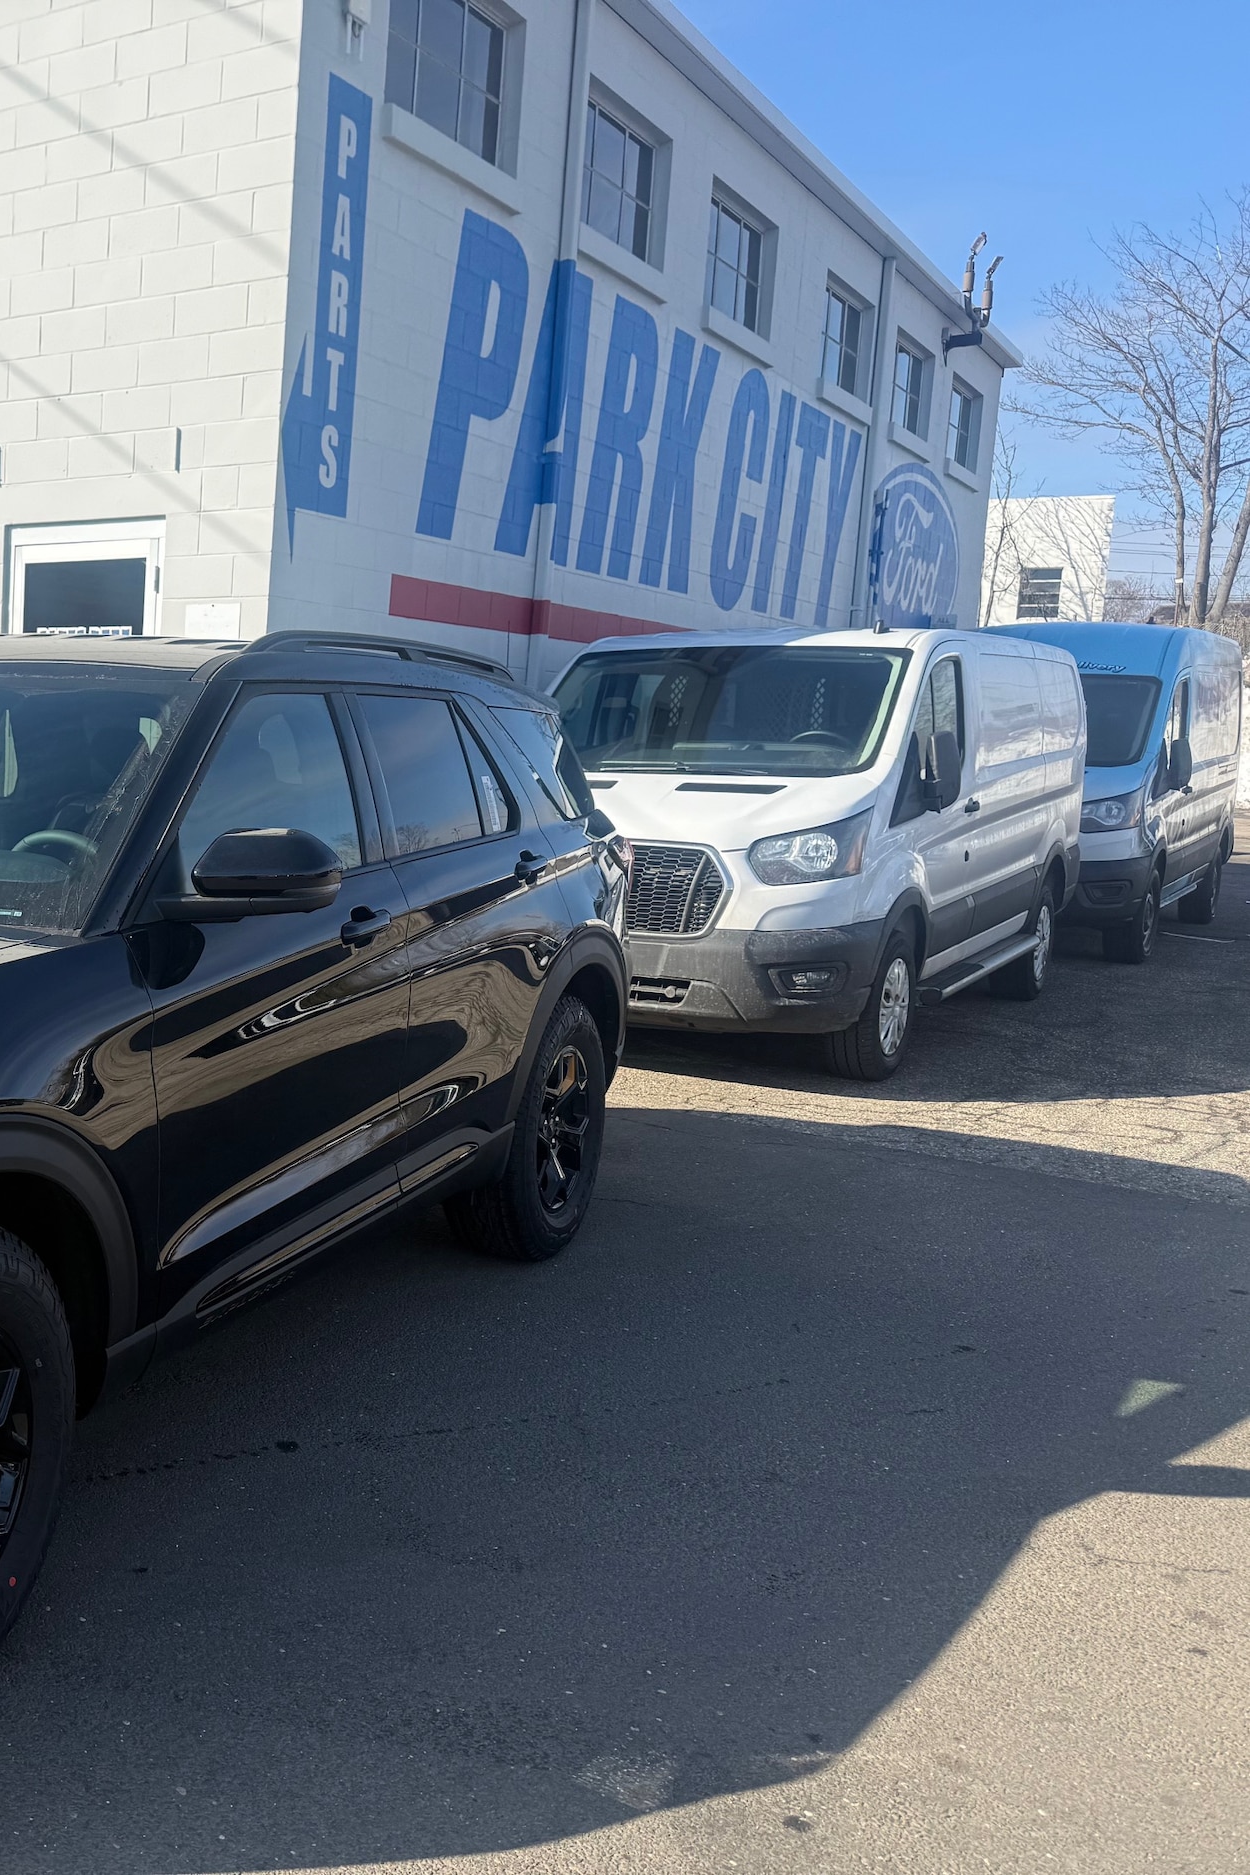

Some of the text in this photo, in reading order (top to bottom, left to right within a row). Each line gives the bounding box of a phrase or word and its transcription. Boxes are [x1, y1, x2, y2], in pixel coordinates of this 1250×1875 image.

[318, 114, 358, 488] PARTS
[415, 207, 863, 628] PARK CITY
[883, 492, 944, 616] Ford
[1077, 661, 1127, 673] livery
